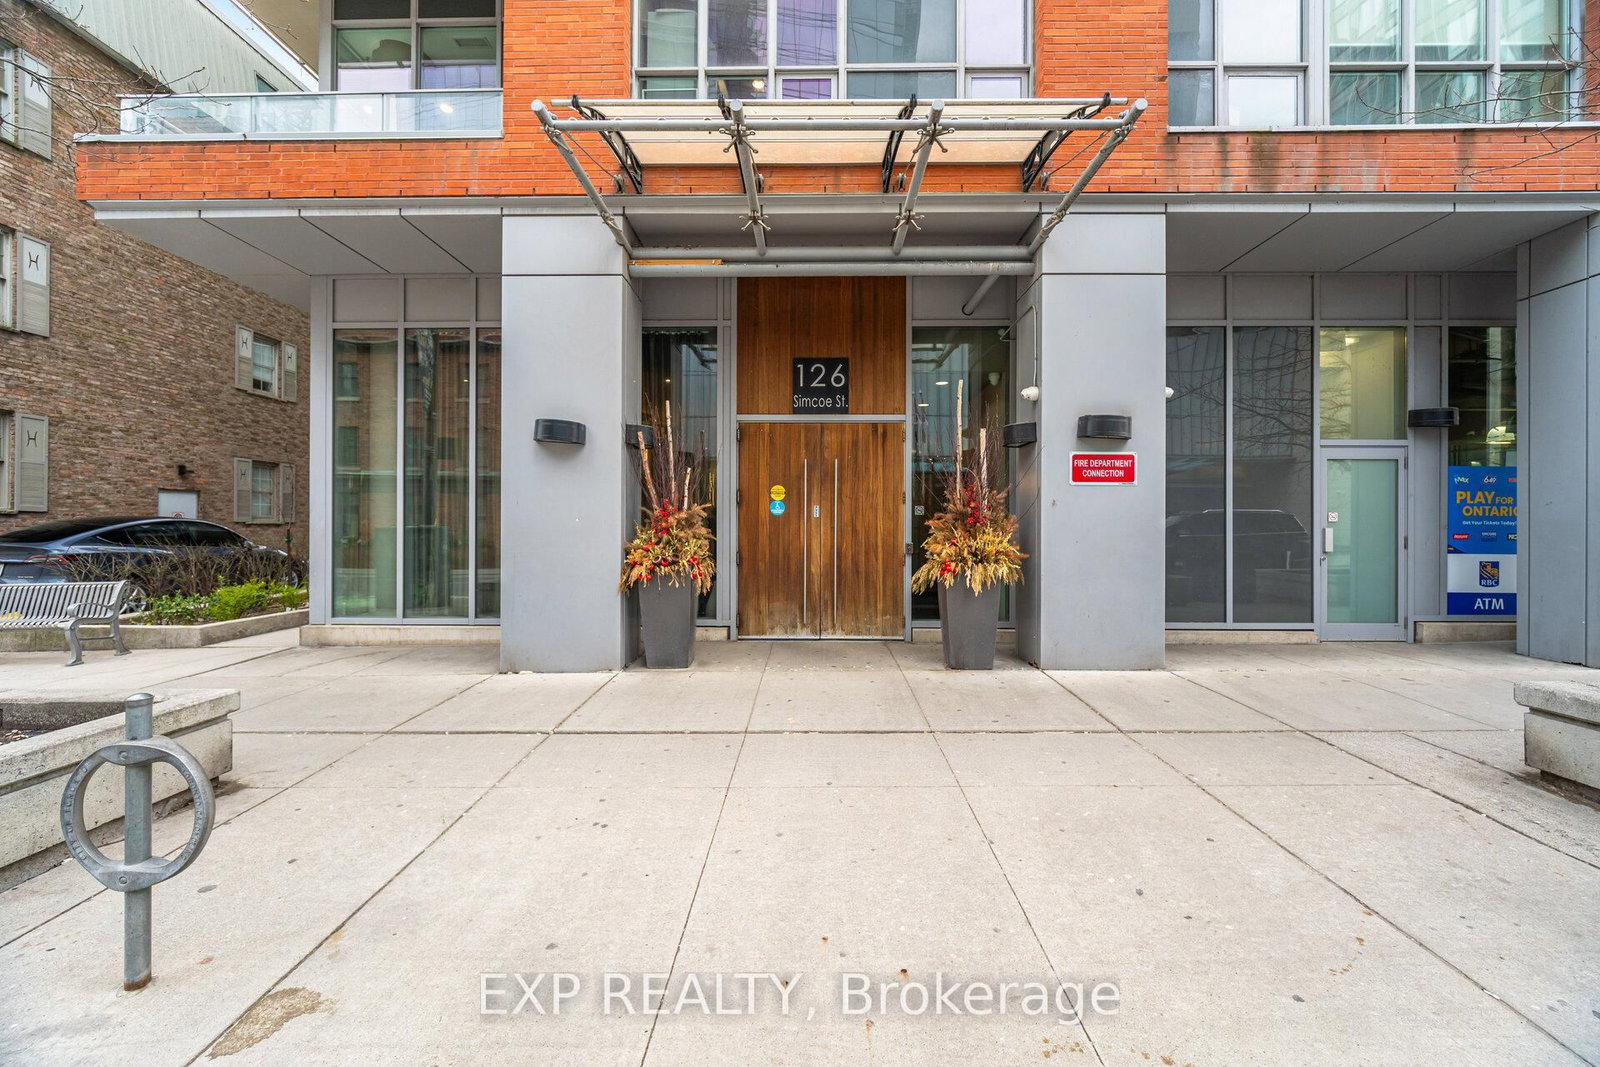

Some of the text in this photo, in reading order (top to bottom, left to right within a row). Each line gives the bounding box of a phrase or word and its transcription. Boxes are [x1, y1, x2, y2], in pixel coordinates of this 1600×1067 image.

[797, 363, 845, 387] 126
[793, 394, 849, 408] Simcoe St.
[1074, 459, 1133, 468] FIRE DEPARTMENT
[1082, 469, 1124, 478] CONNECTION
[1456, 490, 1514, 504] PLAY FOR
[1481, 579, 1498, 587] RBC
[1474, 598, 1505, 610] ATM
